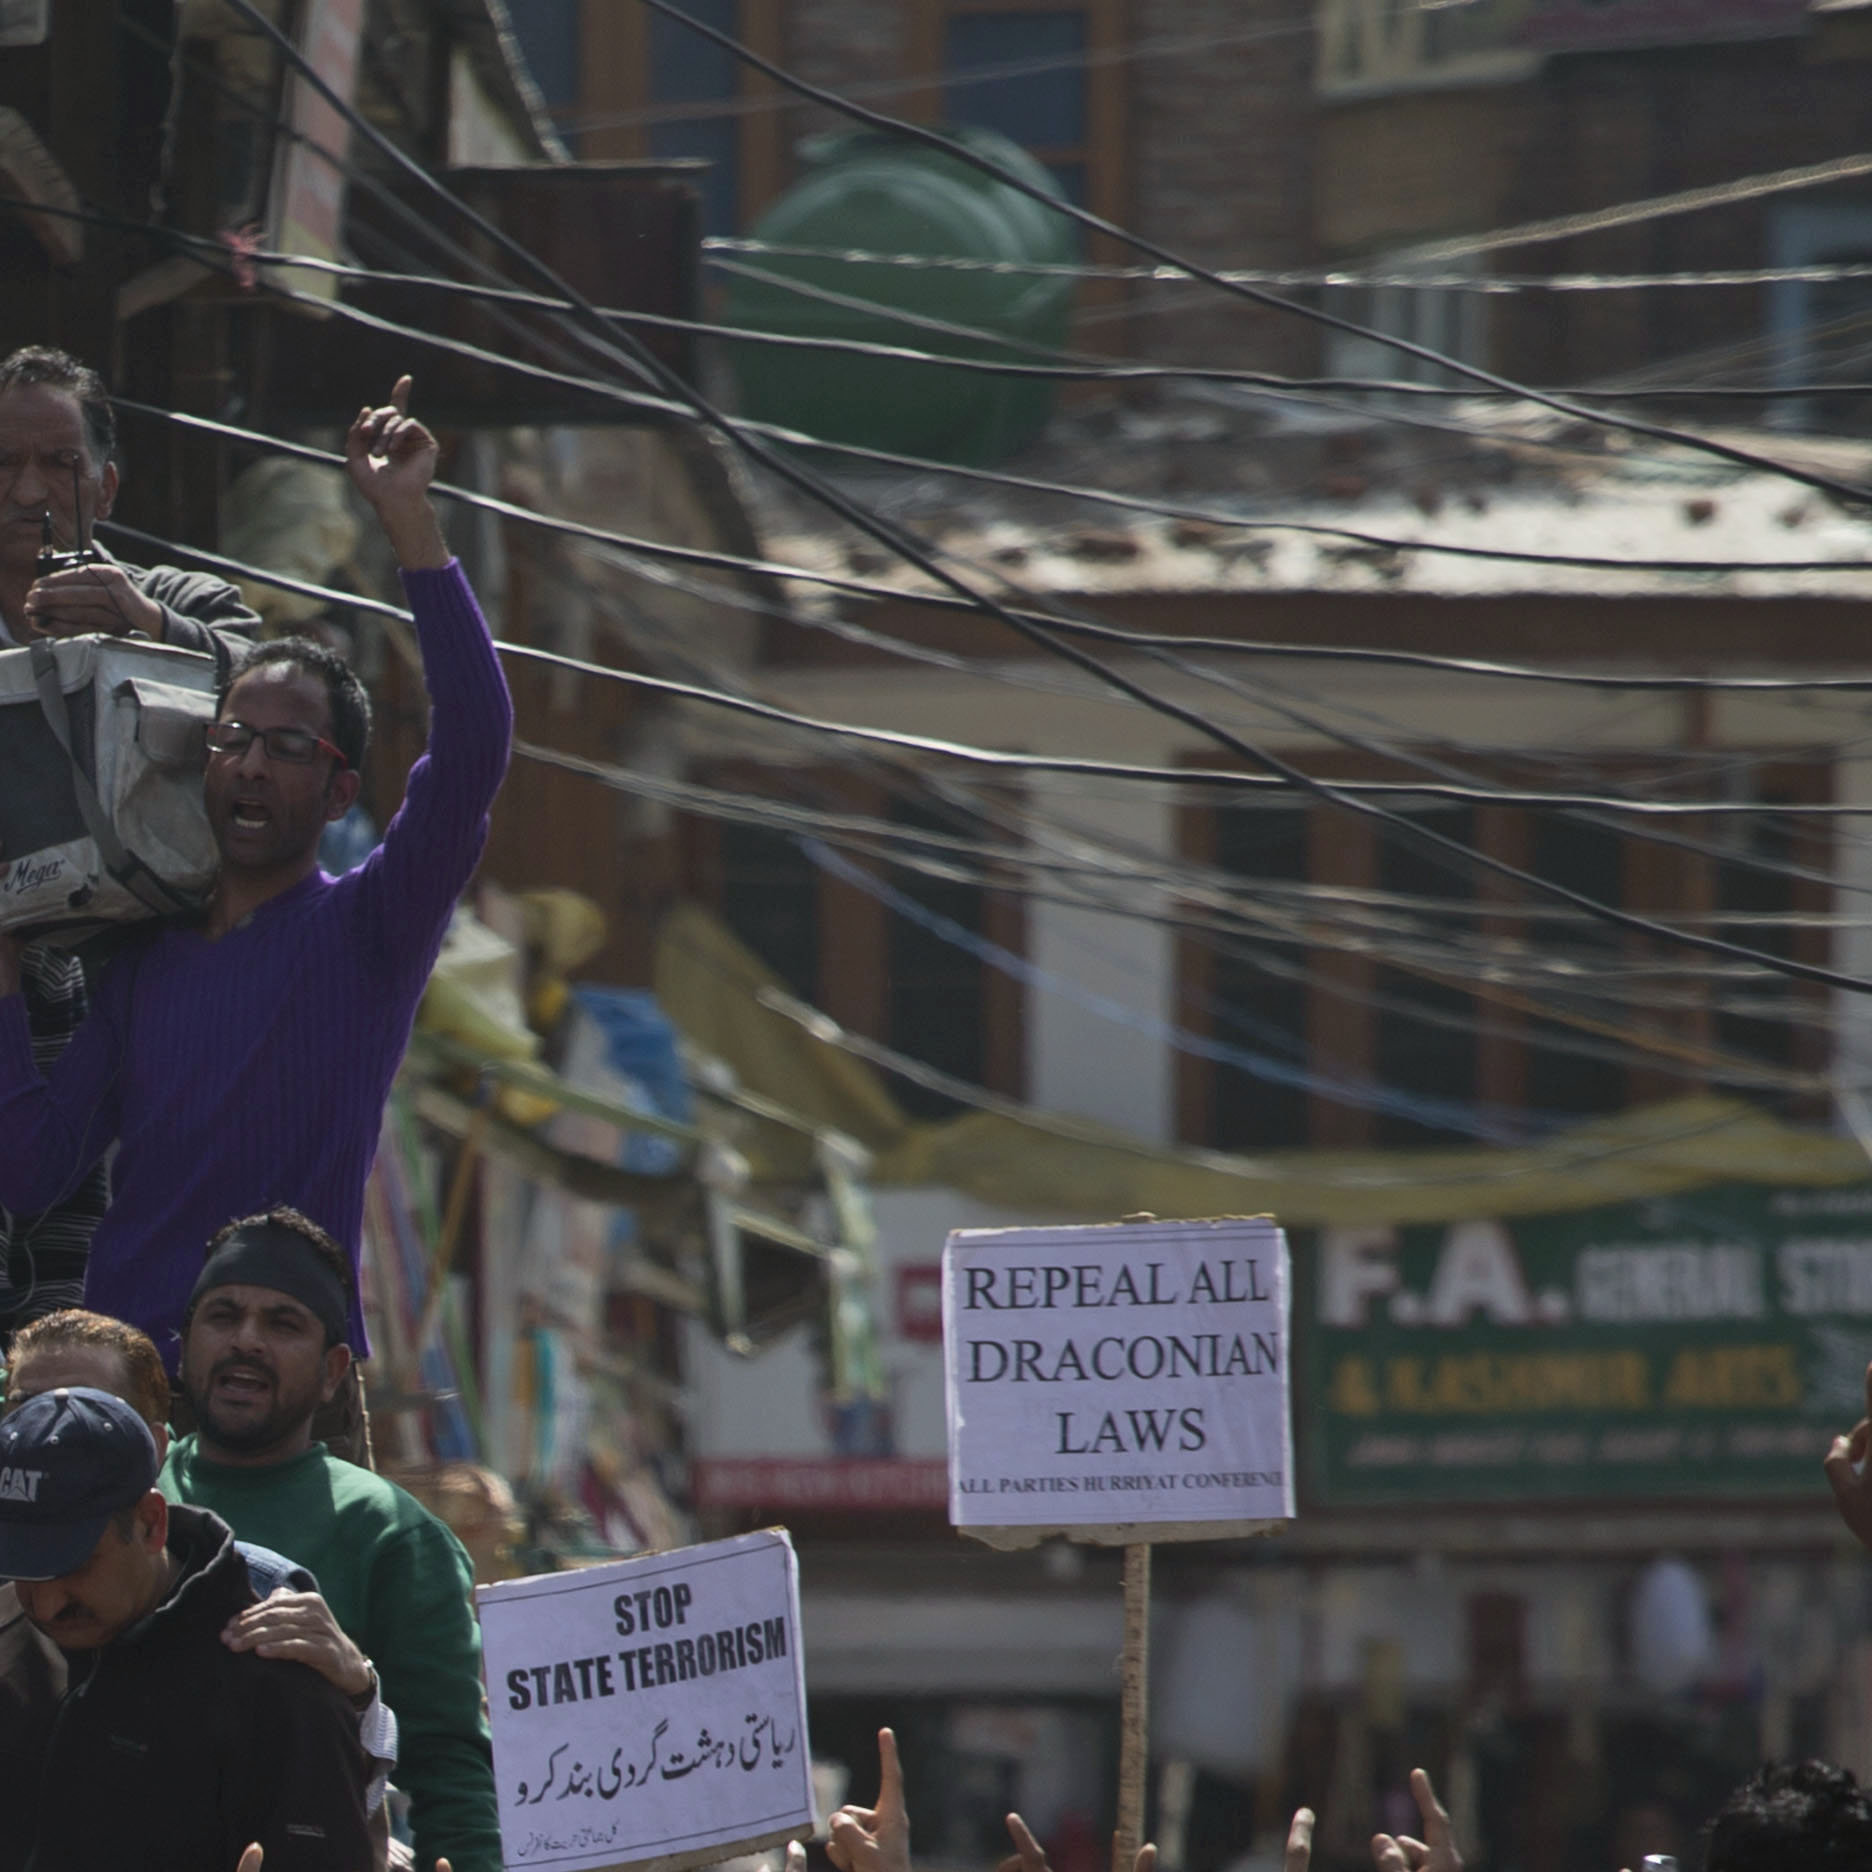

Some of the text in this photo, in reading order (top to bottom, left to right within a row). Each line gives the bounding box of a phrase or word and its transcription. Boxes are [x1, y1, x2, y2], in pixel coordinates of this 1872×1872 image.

[963, 1262, 1178, 1311] REPEAL
[1186, 1259, 1269, 1305] ALL
[966, 1331, 1279, 1384] DRACONIAN
[1055, 1407, 1207, 1455] LAWS
[999, 1476, 1079, 1494] PARTIES
[1083, 1473, 1178, 1492] HURRIYAT
[614, 1582, 692, 1637] STOP
[506, 1616, 787, 1711] STATE TERRORISM
[739, 1714, 795, 1770] ریاستی
